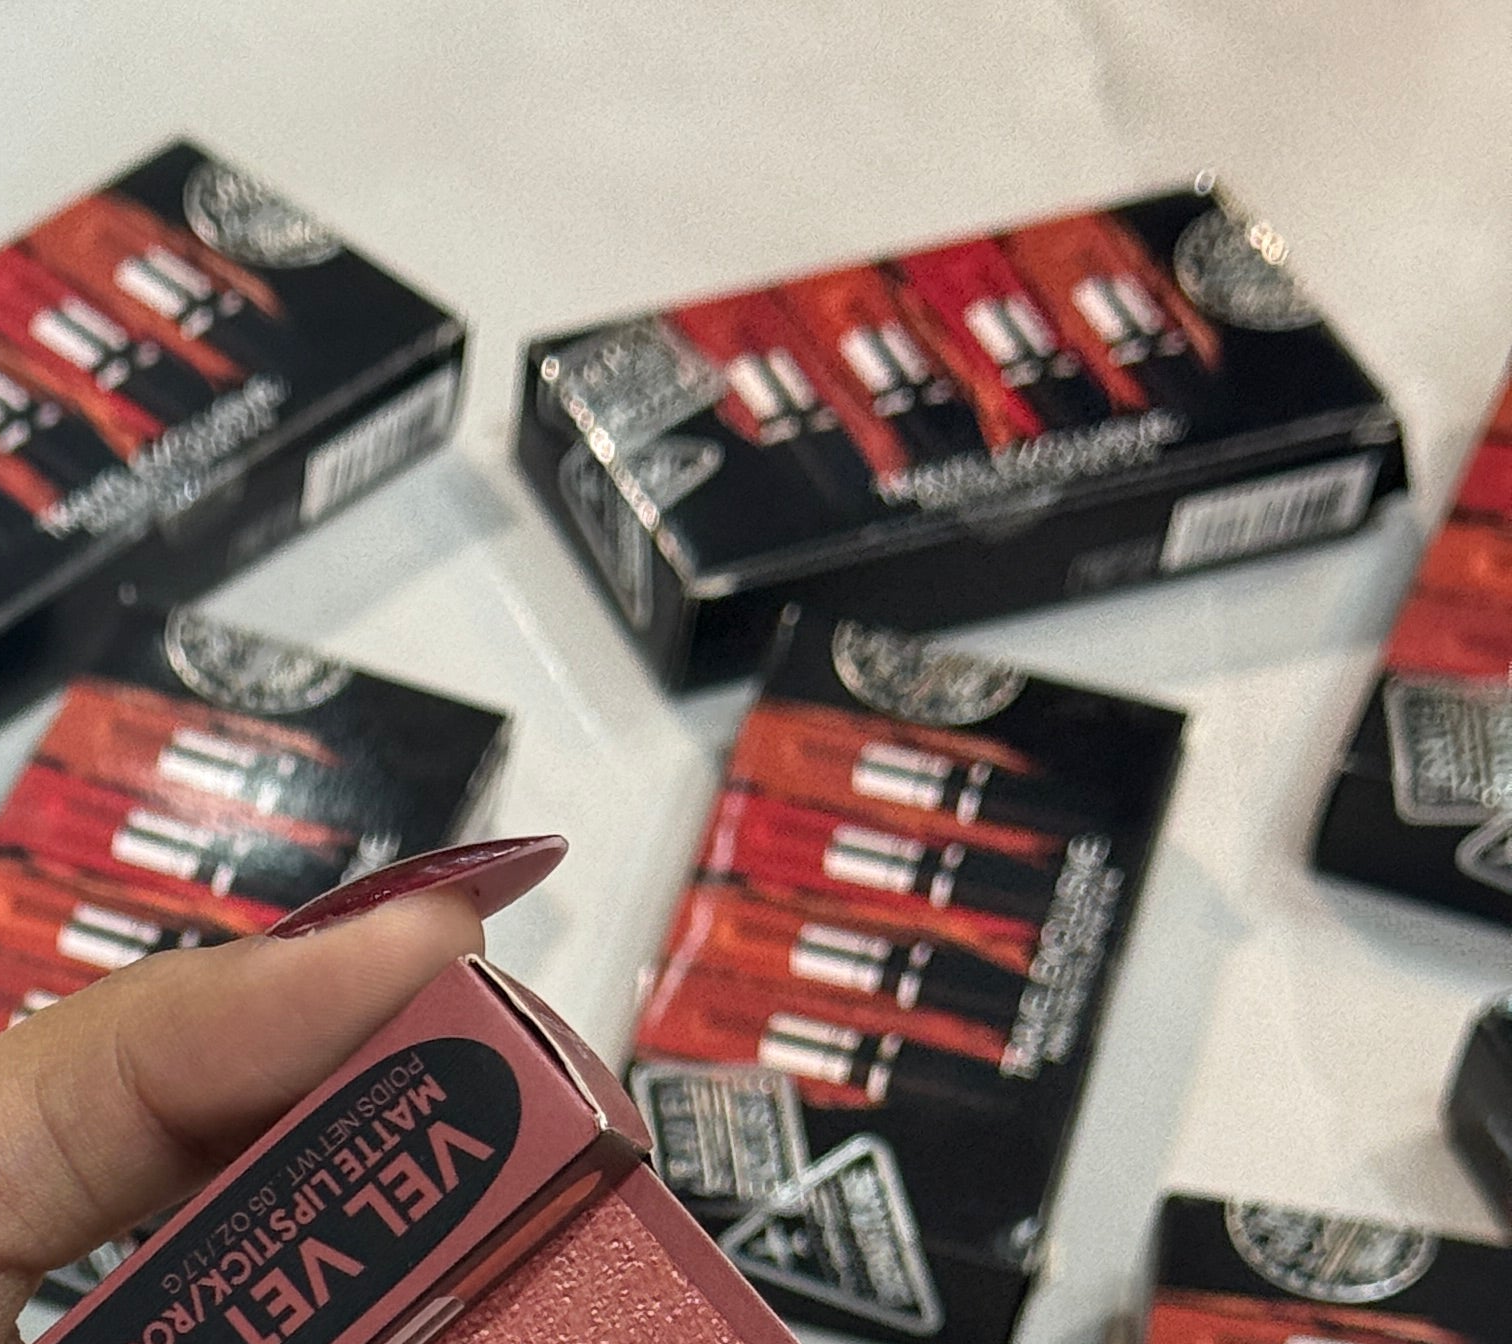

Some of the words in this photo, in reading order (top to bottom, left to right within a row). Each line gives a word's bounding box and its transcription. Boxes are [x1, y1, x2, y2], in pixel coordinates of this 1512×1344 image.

[312, 1106, 363, 1155] NET
[328, 1071, 453, 1187] MATTE
[351, 1050, 425, 1119] POIDS
[338, 1104, 497, 1254] VEL
